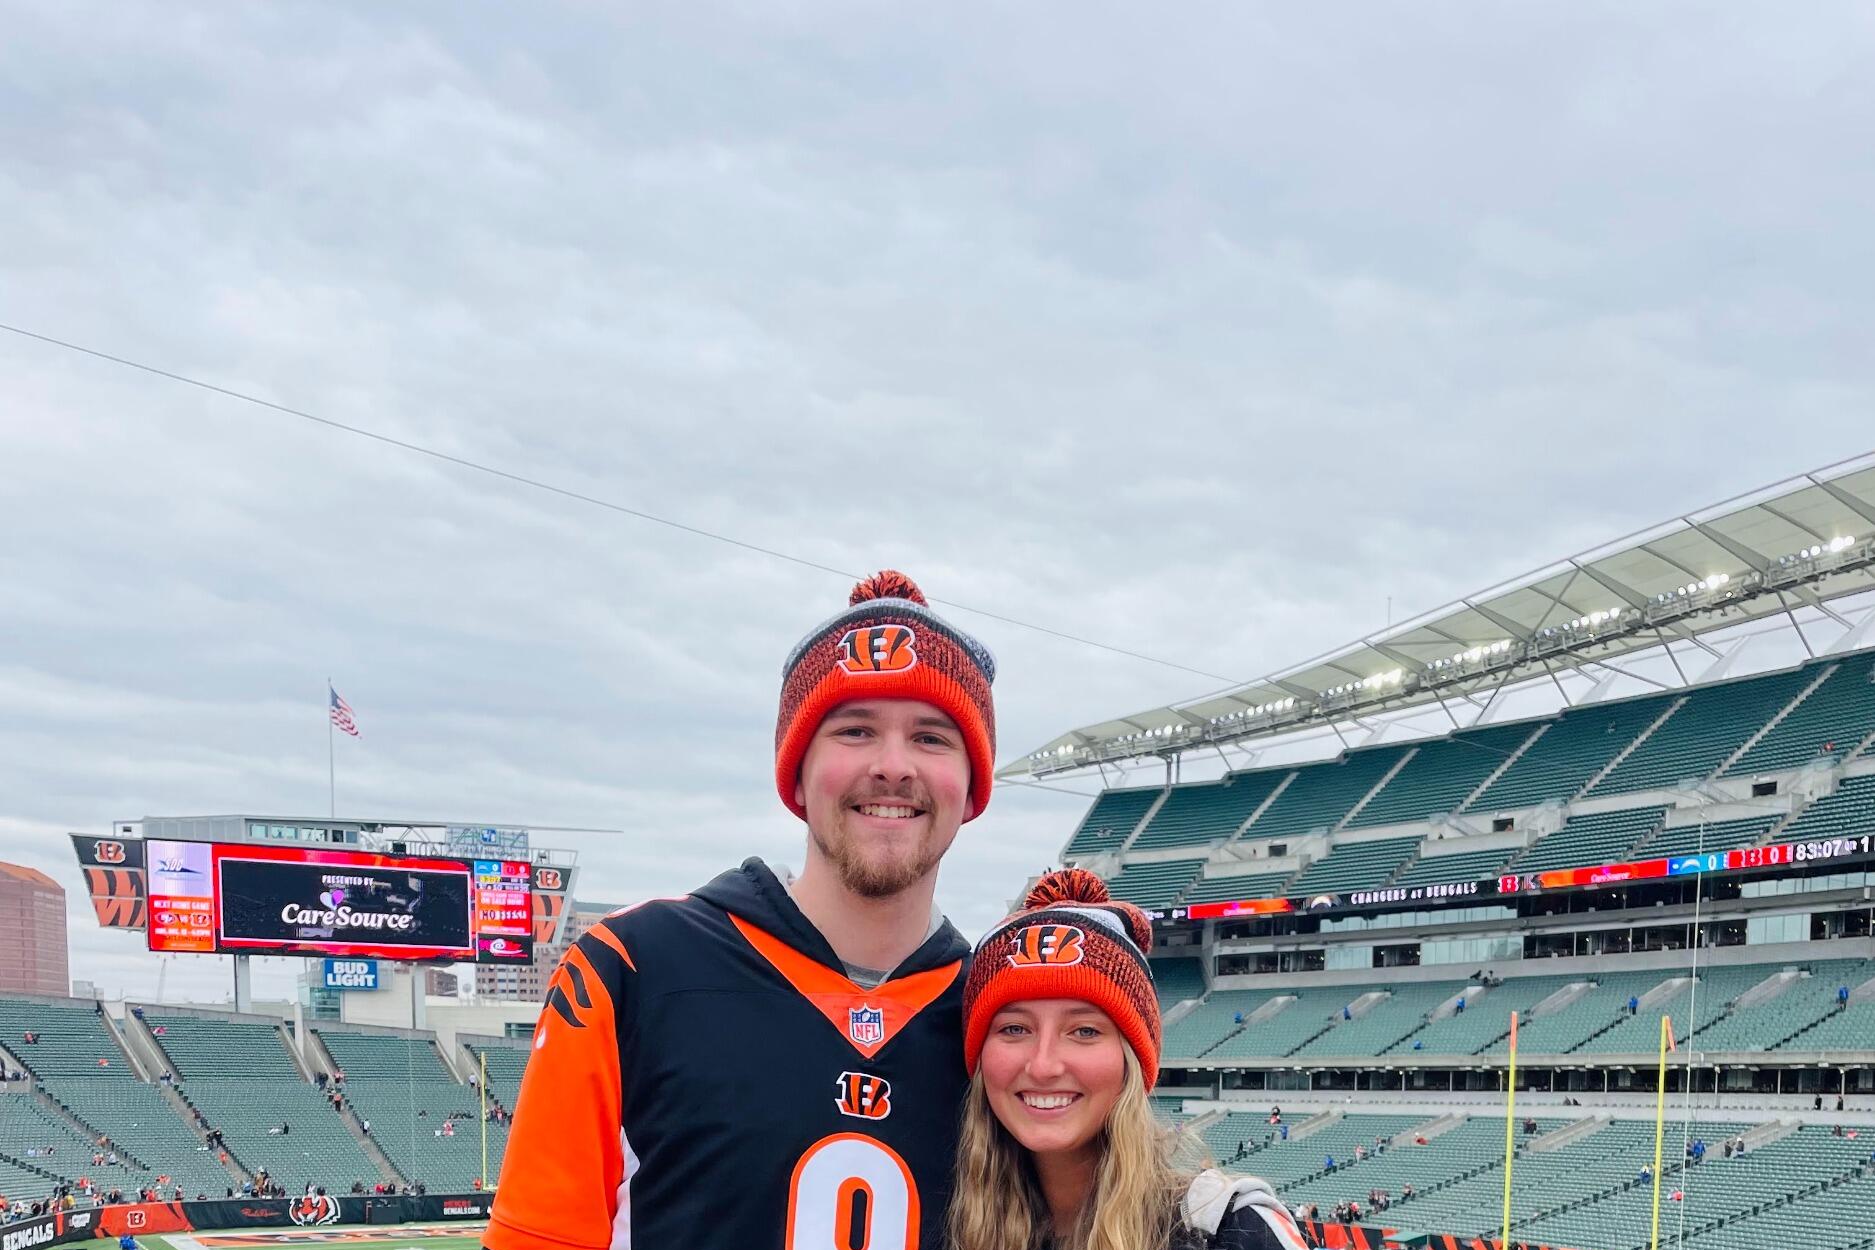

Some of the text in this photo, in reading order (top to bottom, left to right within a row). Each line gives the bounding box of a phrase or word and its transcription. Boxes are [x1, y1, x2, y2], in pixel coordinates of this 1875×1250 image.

[1350, 889, 1407, 904] CHARGERS
[1426, 882, 1477, 898] BENGALS
[281, 903, 413, 929] CareSource
[333, 961, 369, 974] BUD
[326, 973, 375, 987] LIGHT
[855, 1023, 879, 1039] NFL
